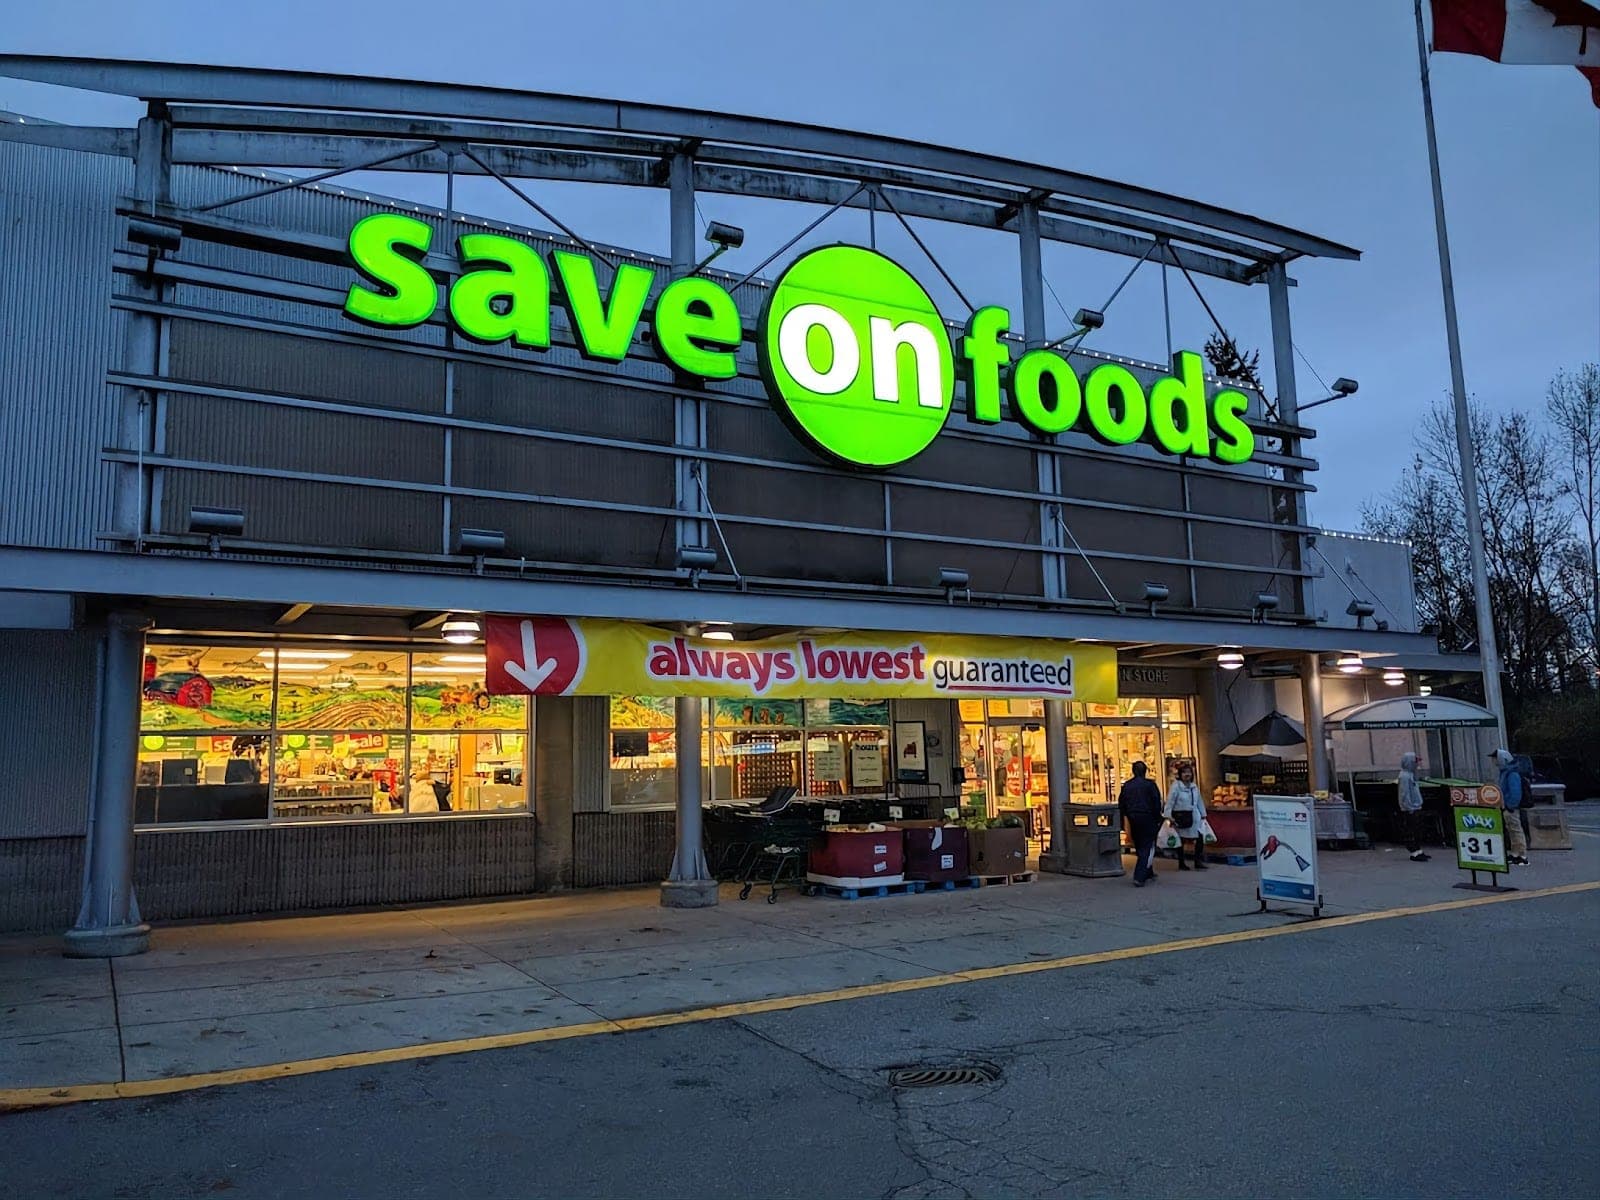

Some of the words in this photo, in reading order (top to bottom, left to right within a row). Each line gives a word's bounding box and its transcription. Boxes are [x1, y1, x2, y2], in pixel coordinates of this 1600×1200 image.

[344, 213, 742, 378] save
[778, 303, 945, 408] on
[959, 306, 1255, 464] foods
[649, 638, 796, 691] always
[801, 641, 925, 679] lowest
[933, 658, 1072, 689] guaranteed
[1134, 669, 1168, 682] STORE
[352, 734, 383, 748] sale
[1462, 813, 1493, 829] MAX
